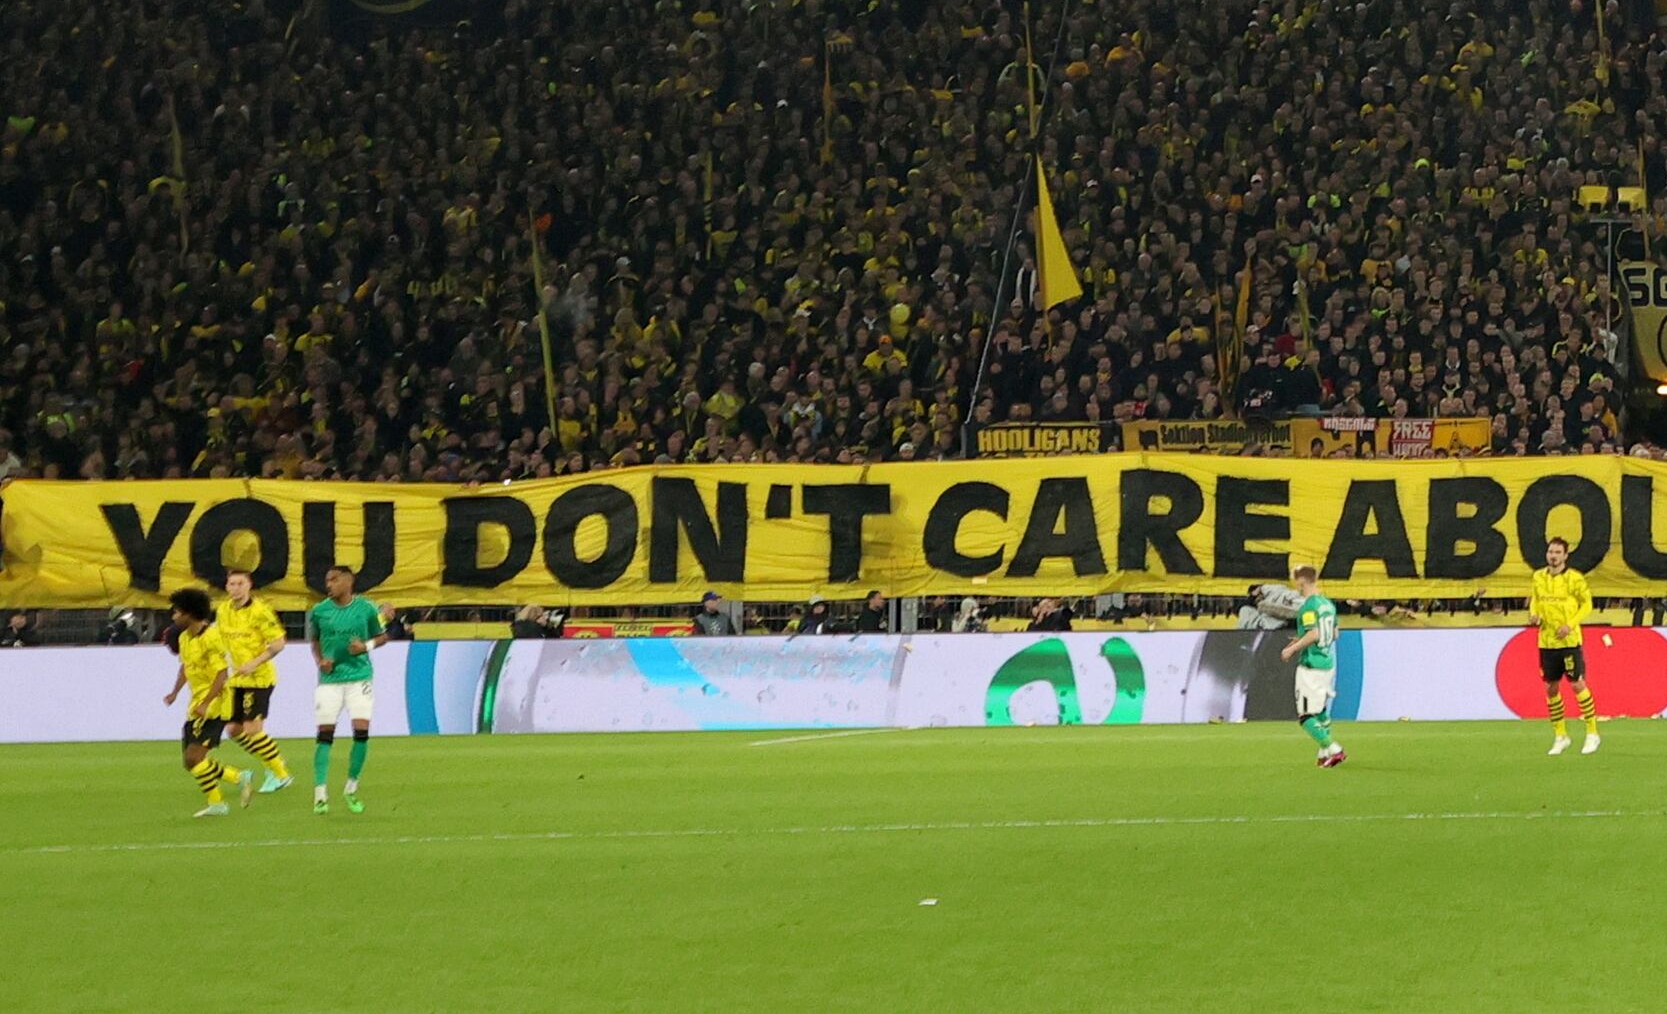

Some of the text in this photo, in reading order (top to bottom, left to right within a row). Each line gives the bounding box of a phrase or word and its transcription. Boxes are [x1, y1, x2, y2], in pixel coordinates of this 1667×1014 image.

[977, 428, 1100, 453] HOOLIGANS
[101, 498, 396, 593] YOU
[441, 477, 891, 587] DON'T
[923, 469, 1292, 578] CARE
